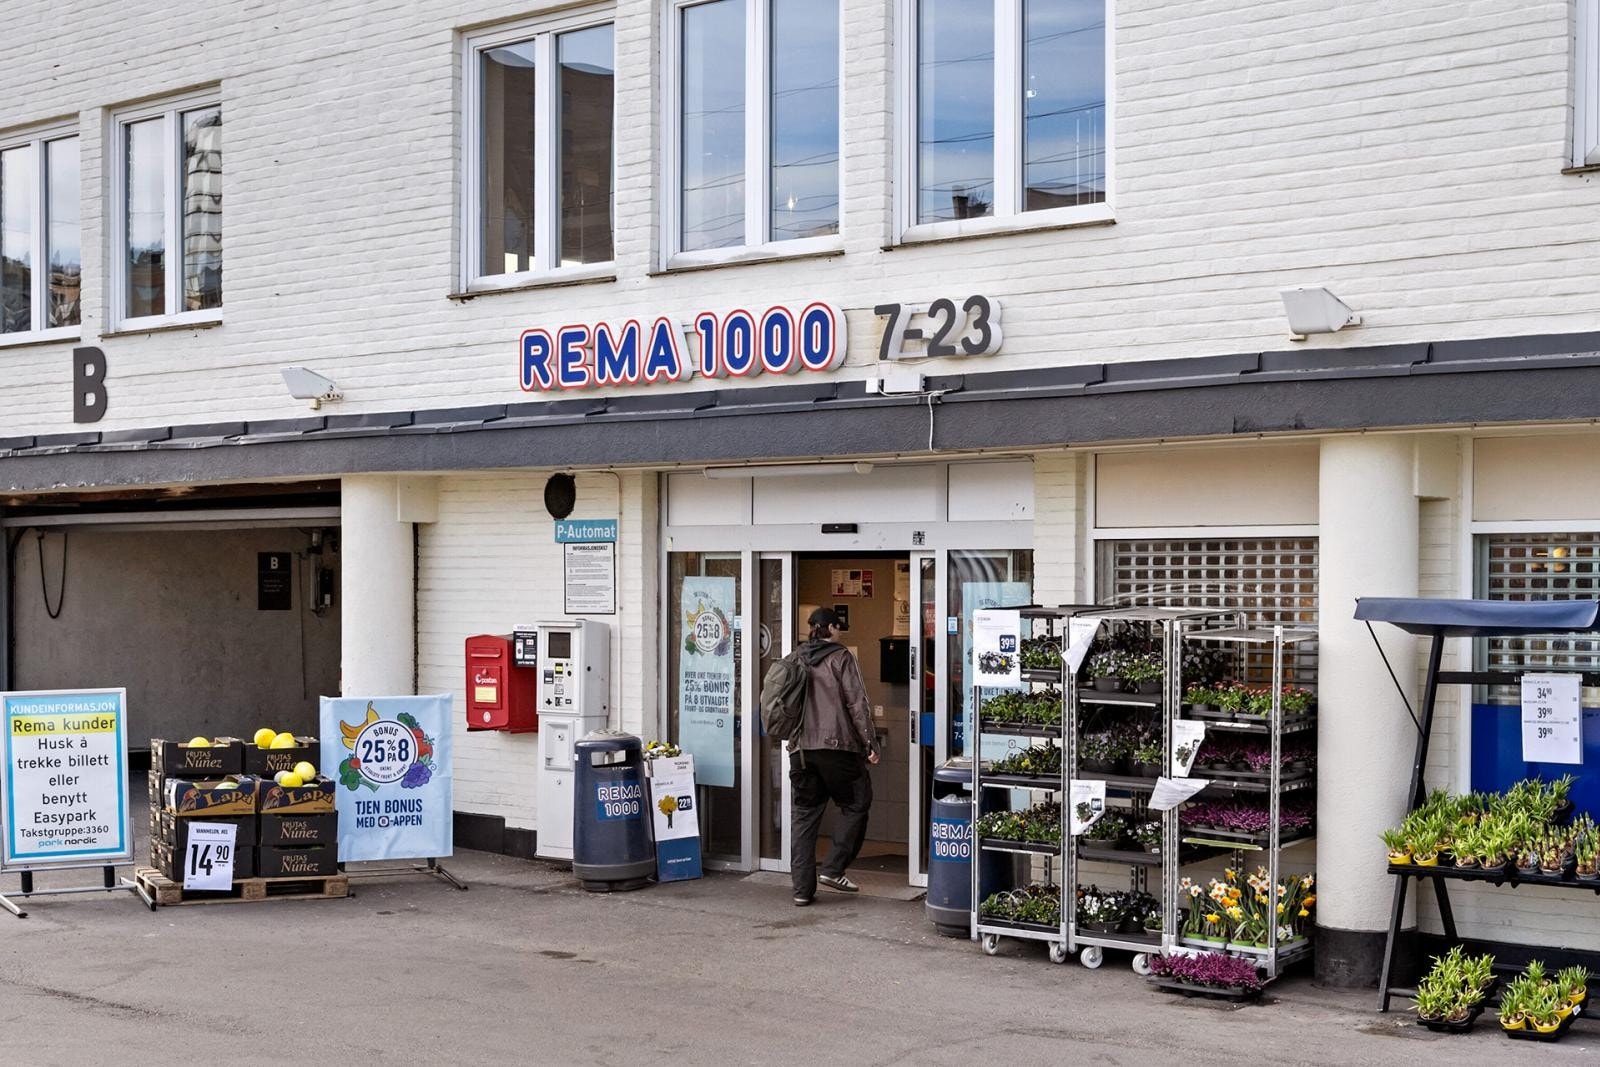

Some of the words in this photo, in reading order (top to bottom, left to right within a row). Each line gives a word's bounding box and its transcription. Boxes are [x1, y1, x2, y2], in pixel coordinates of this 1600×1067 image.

[520, 317, 683, 391] REMA
[695, 302, 836, 378] 1000
[874, 295, 992, 361] 7-23
[73, 346, 108, 423] B
[557, 524, 616, 538] P-Automat
[270, 556, 279, 570] B
[704, 681, 730, 694] BONUS
[10, 702, 116, 715] KUNDEINFORMASJON
[13, 719, 55, 733] Rema
[63, 717, 115, 731] kunder
[373, 726, 399, 737] BONUS
[38, 738, 74, 751] Husk
[80, 737, 88, 749] å
[362, 740, 385, 763] 25
[398, 739, 409, 762] 8
[185, 750, 212, 758] FRUTAS
[266, 753, 292, 761] FRUTAS
[17, 757, 62, 770] trekke
[69, 754, 109, 768] billett
[49, 774, 79, 786] eller
[42, 792, 87, 807] benytt
[597, 785, 641, 801] REMA
[356, 801, 380, 815] TJEN
[385, 799, 423, 814] BONUS
[604, 802, 639, 817] 1000
[34, 809, 96, 826] Easypark
[356, 816, 375, 828] MED
[281, 821, 307, 829] FRUTAS
[932, 822, 973, 840] REMA
[64, 836, 97, 846] nordic
[935, 841, 970, 858] 1000
[282, 855, 308, 863] FRUTAS
